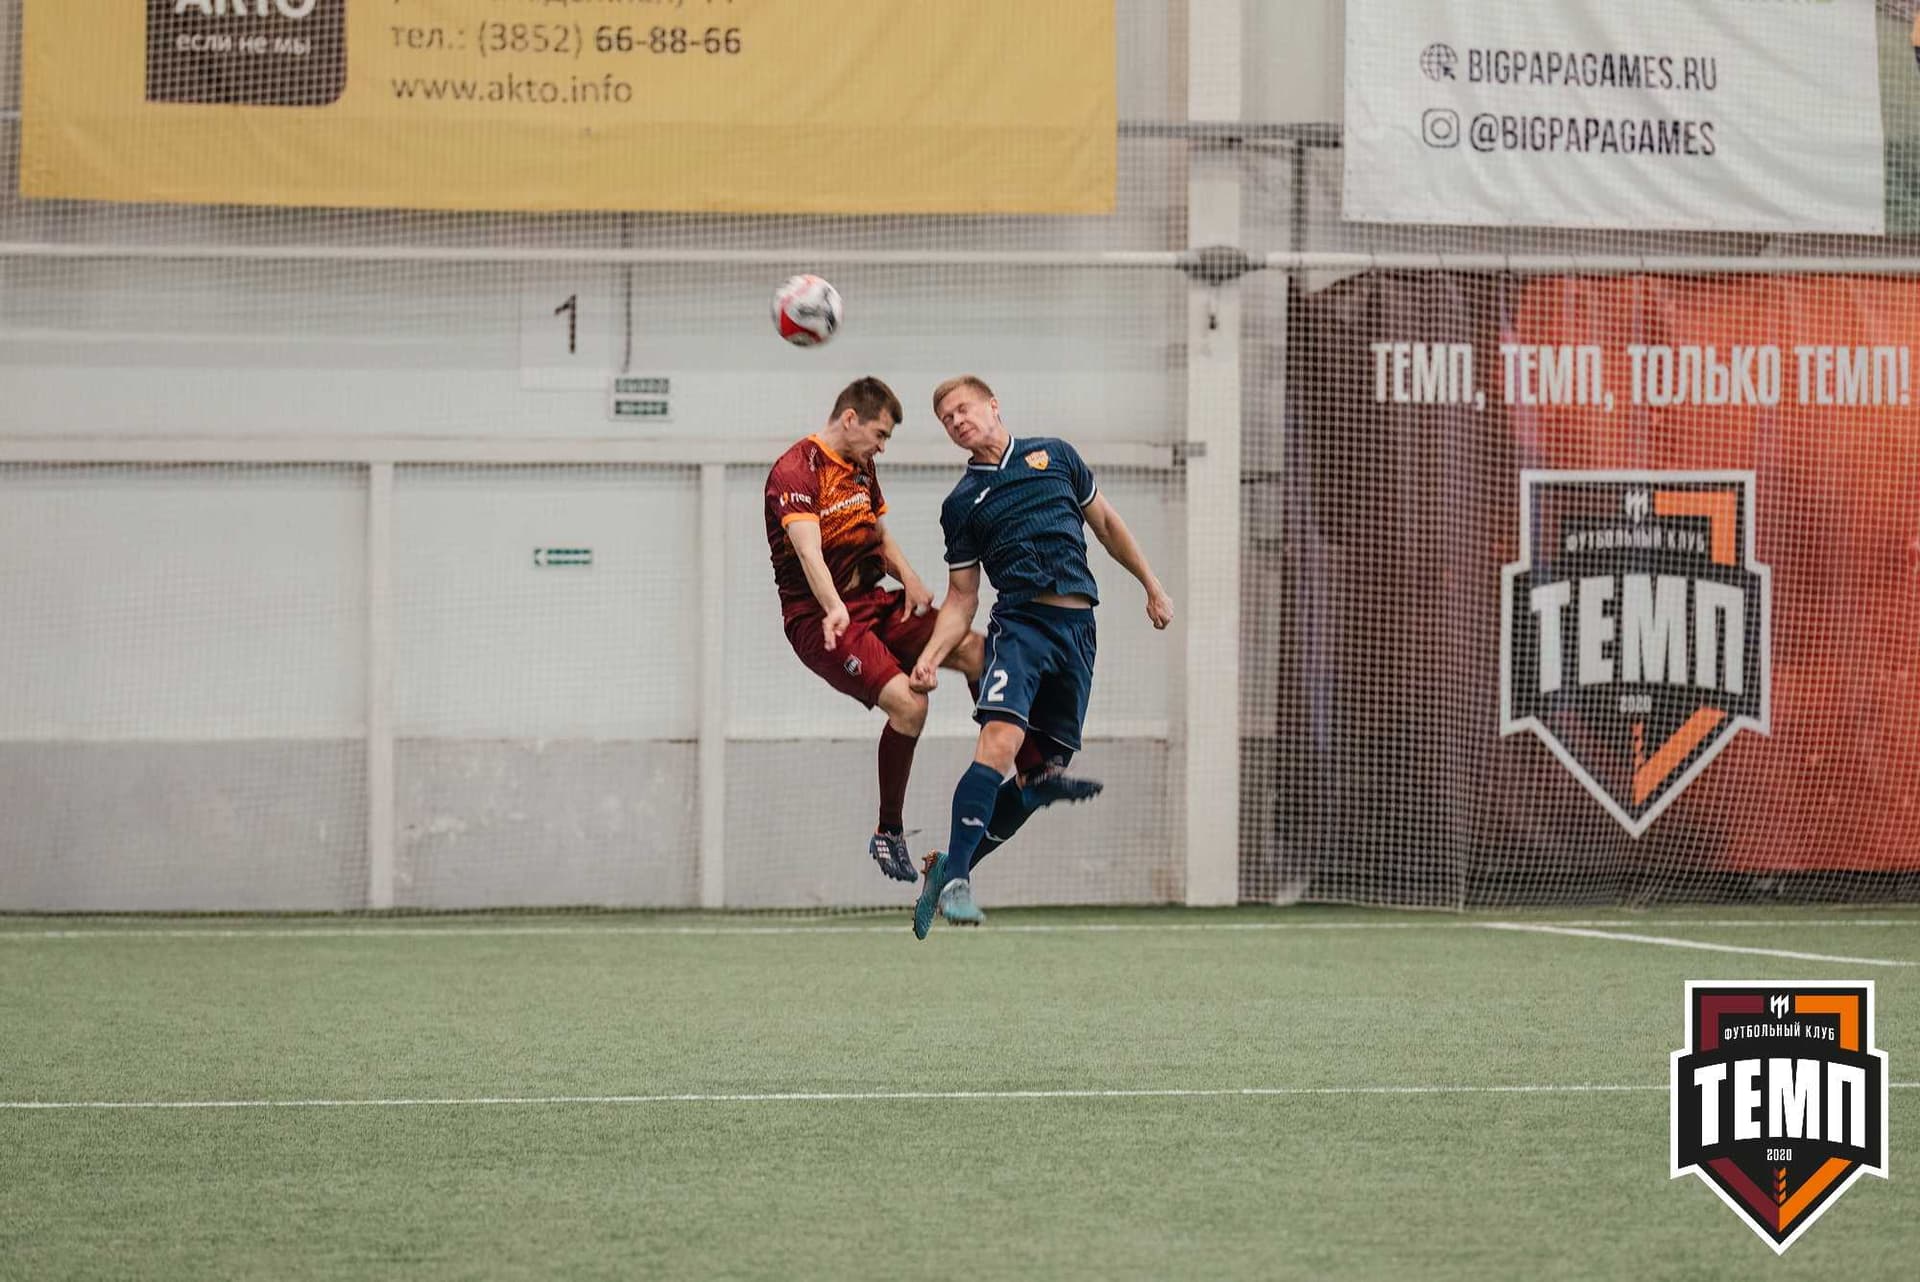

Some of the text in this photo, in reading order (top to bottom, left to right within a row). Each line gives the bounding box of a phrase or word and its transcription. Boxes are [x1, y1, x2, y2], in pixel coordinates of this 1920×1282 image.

[176, 34, 311, 55] если не мы
[392, 21, 741, 58] тел.: (3852) 66-88-66
[392, 73, 632, 103] www.akto.info
[1468, 49, 1717, 91] BIGPAPAGAMES.RU
[1470, 112, 1716, 156] @BIGPAPAGAMES
[555, 295, 576, 353] 1
[1371, 342, 1910, 412] ТЕМП, ТЕМП, ТОЛЬКО ТЕМП!
[1668, 530, 1705, 553] КЛУБ
[1530, 574, 1744, 695] ТЕМП
[987, 669, 1008, 702] 2
